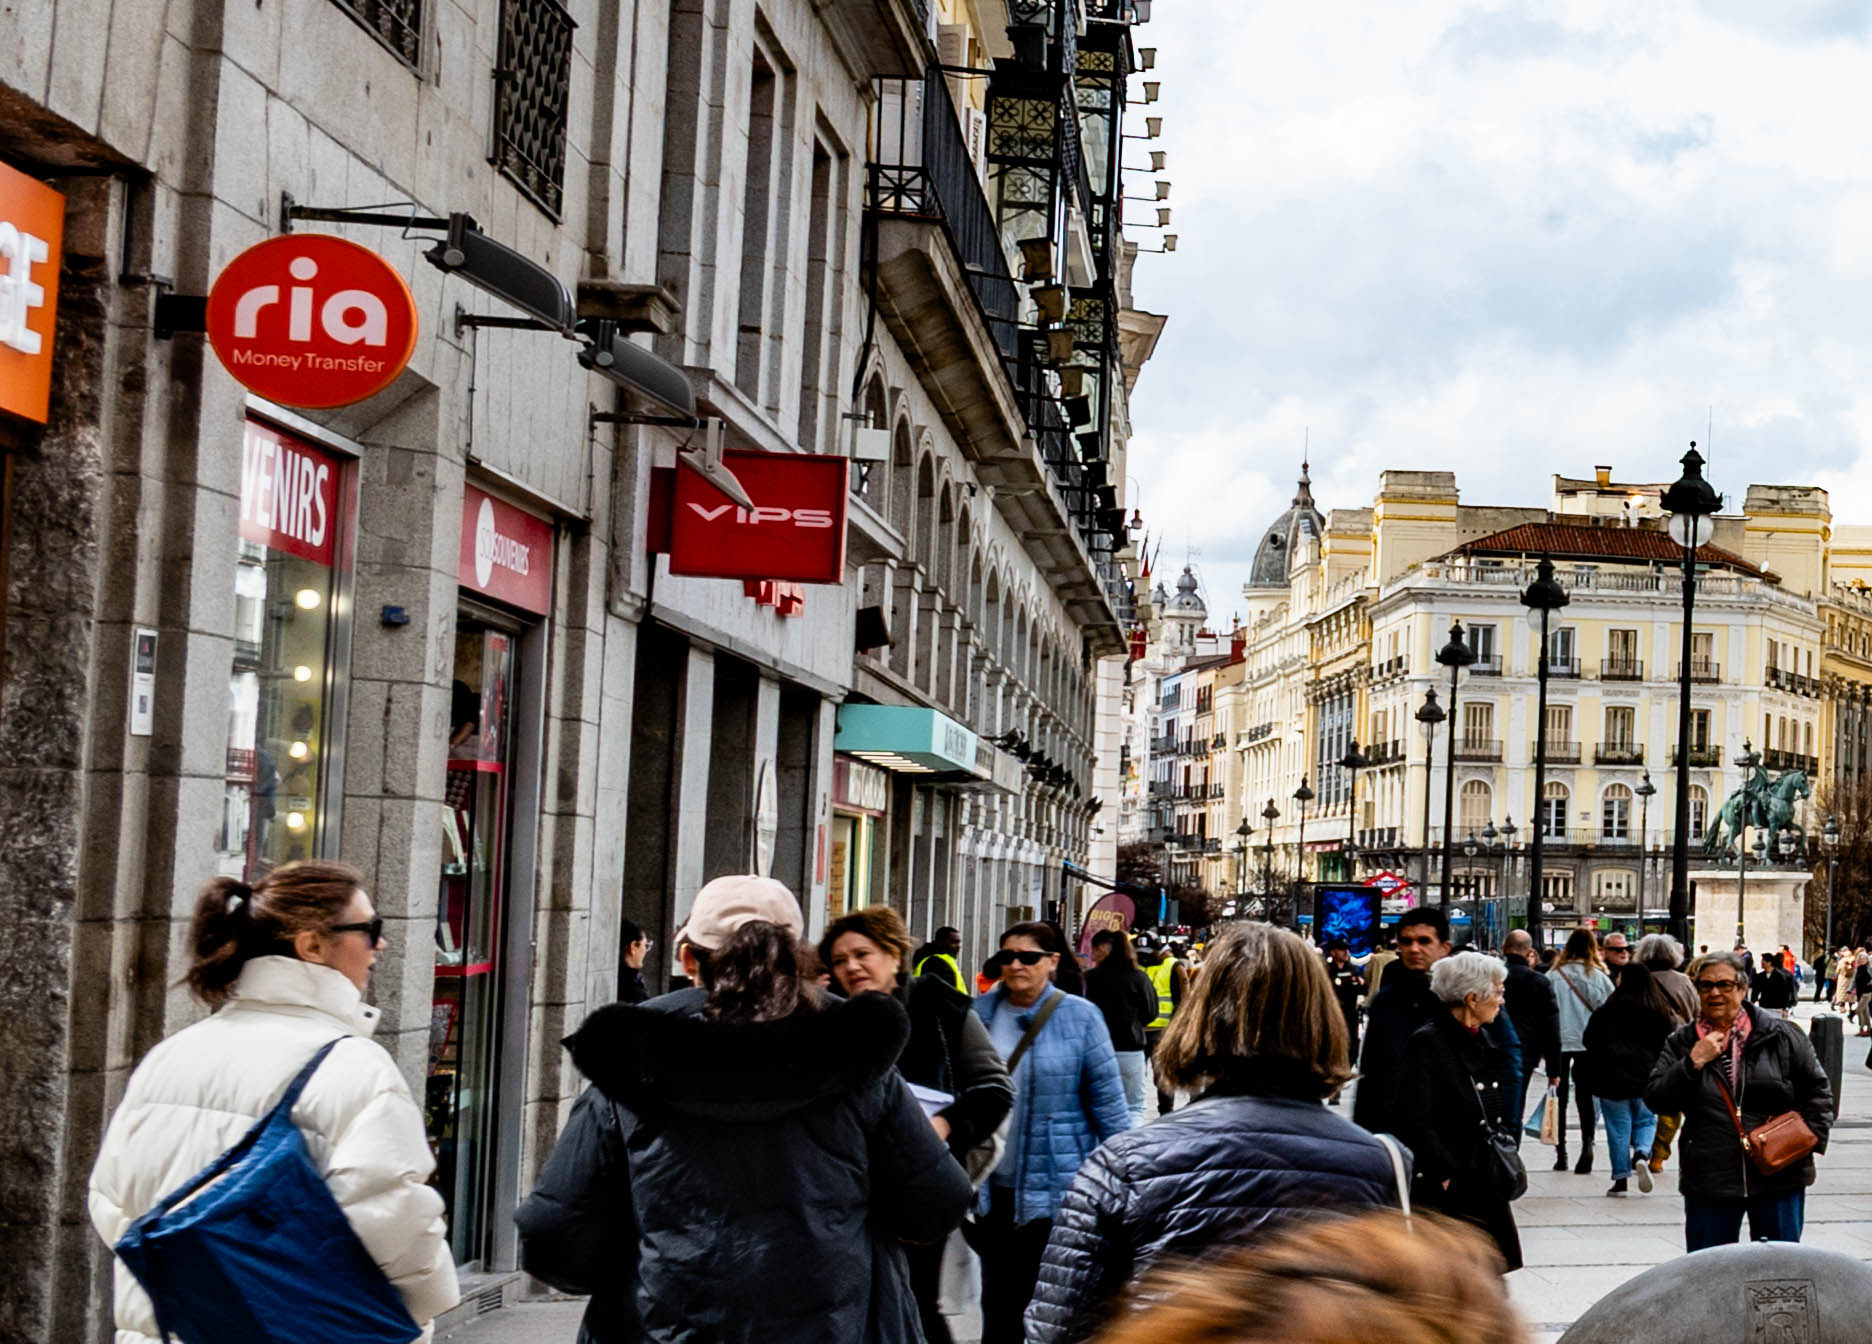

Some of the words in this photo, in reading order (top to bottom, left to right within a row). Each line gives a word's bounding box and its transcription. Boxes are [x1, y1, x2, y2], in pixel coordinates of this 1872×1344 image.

[234, 256, 388, 346] ria
[232, 348, 301, 371] Money
[304, 353, 385, 372] Transfer
[686, 502, 833, 528] VIPS
[492, 532, 530, 577] SOUVENIRS
